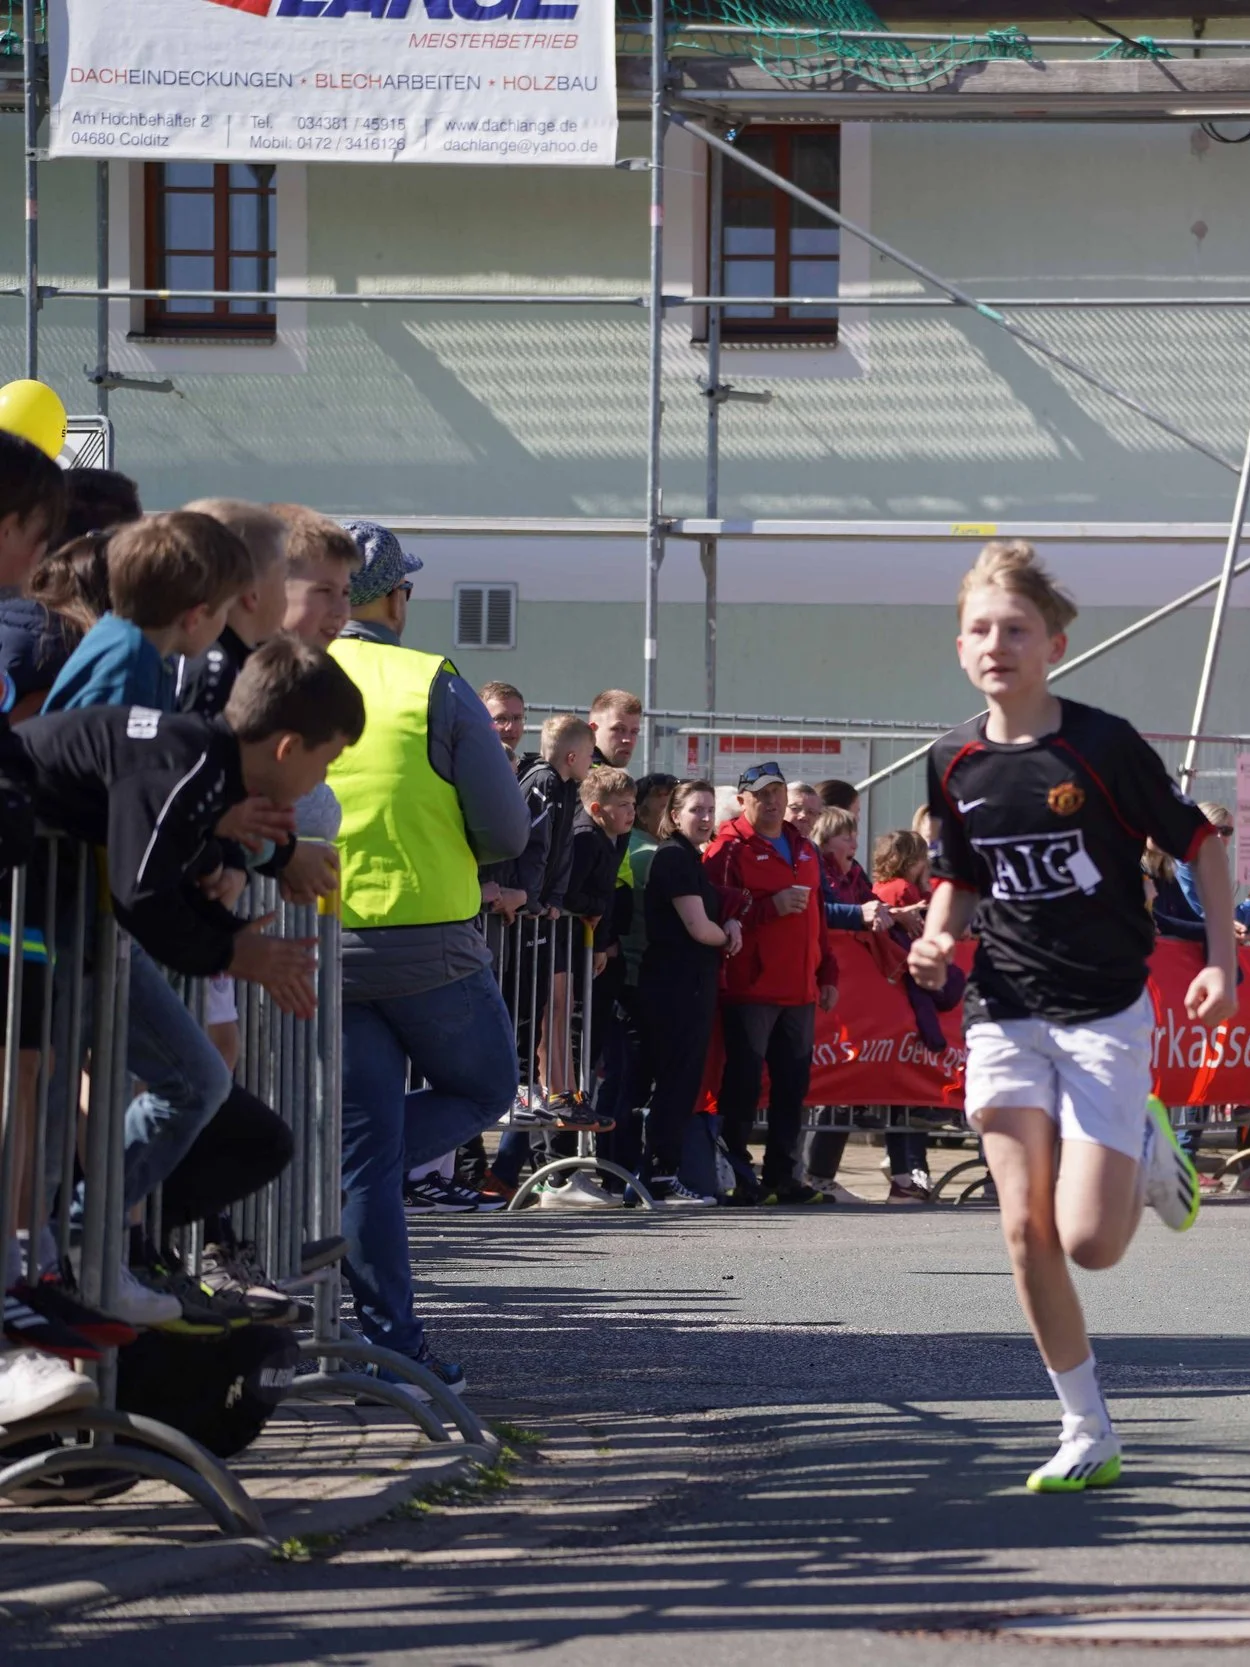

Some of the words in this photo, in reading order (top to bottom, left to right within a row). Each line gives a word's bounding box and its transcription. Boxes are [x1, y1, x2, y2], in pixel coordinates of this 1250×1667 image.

[408, 33, 579, 49] MEISTERBETRIEB
[70, 67, 293, 88] DACHEINDECKUNGEN
[315, 73, 481, 91] BLECHARBEITEN
[503, 76, 597, 92] HOLZBAU
[72, 111, 96, 125] Am
[200, 114, 210, 128] 2
[297, 116, 348, 130] 034381
[363, 117, 406, 131] 45915
[444, 117, 577, 135] www.dachlange.de
[71, 131, 115, 146] 04680
[119, 131, 169, 147] Colditz
[249, 135, 292, 149] Mobil:
[297, 136, 333, 150] 0172
[346, 137, 406, 152] 3416126
[443, 138, 598, 155] dachlange@yahoo.de
